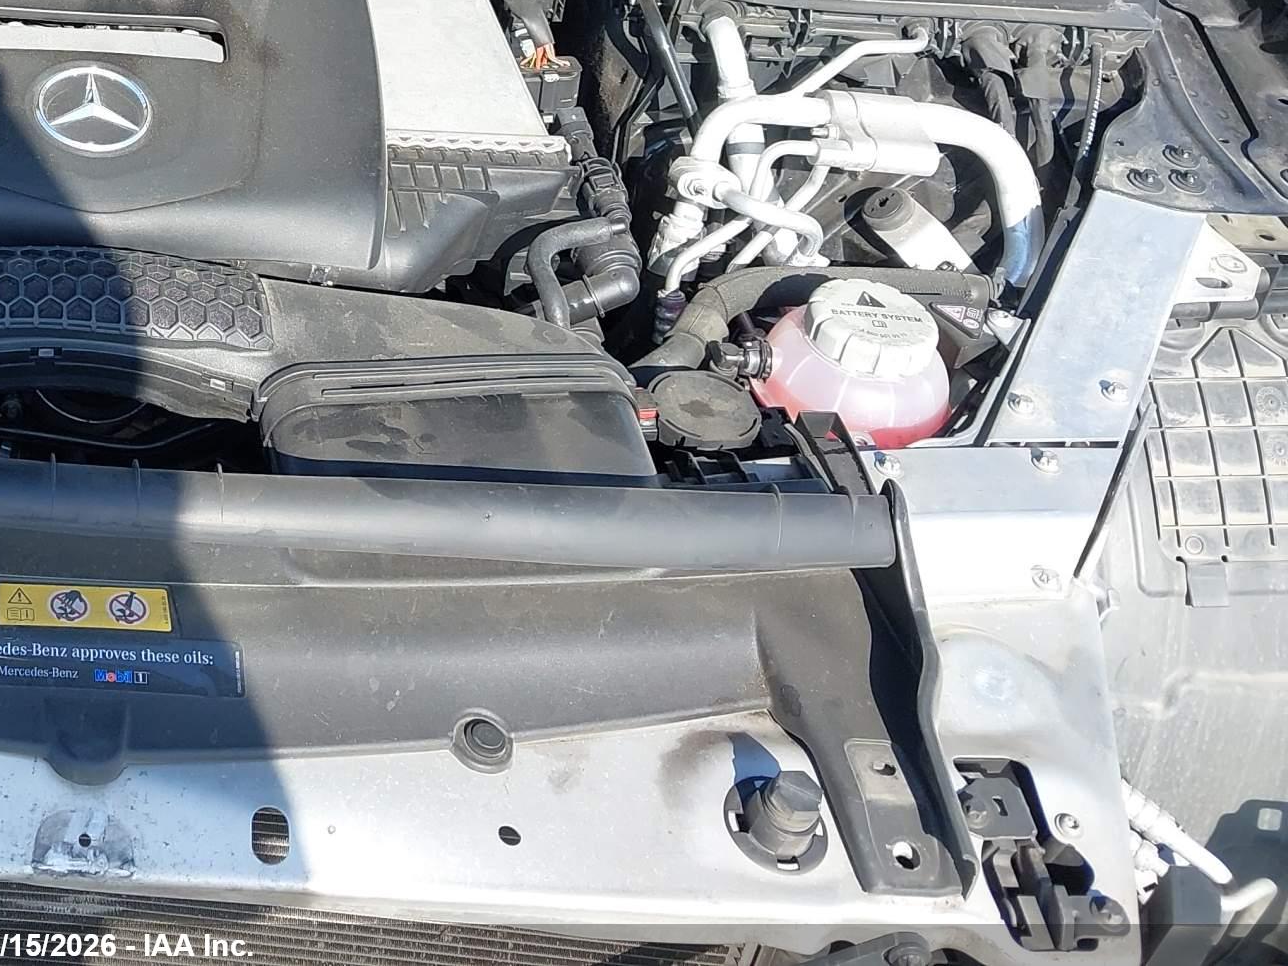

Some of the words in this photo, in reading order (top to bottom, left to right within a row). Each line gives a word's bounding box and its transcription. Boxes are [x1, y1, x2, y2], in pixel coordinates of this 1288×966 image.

[831, 309, 878, 318] BATTERY
[881, 313, 923, 323] SYSTEM
[71, 649, 137, 662] approves
[140, 648, 180, 663] these
[183, 651, 214, 665] oils:
[94, 669, 132, 683] Mobil
